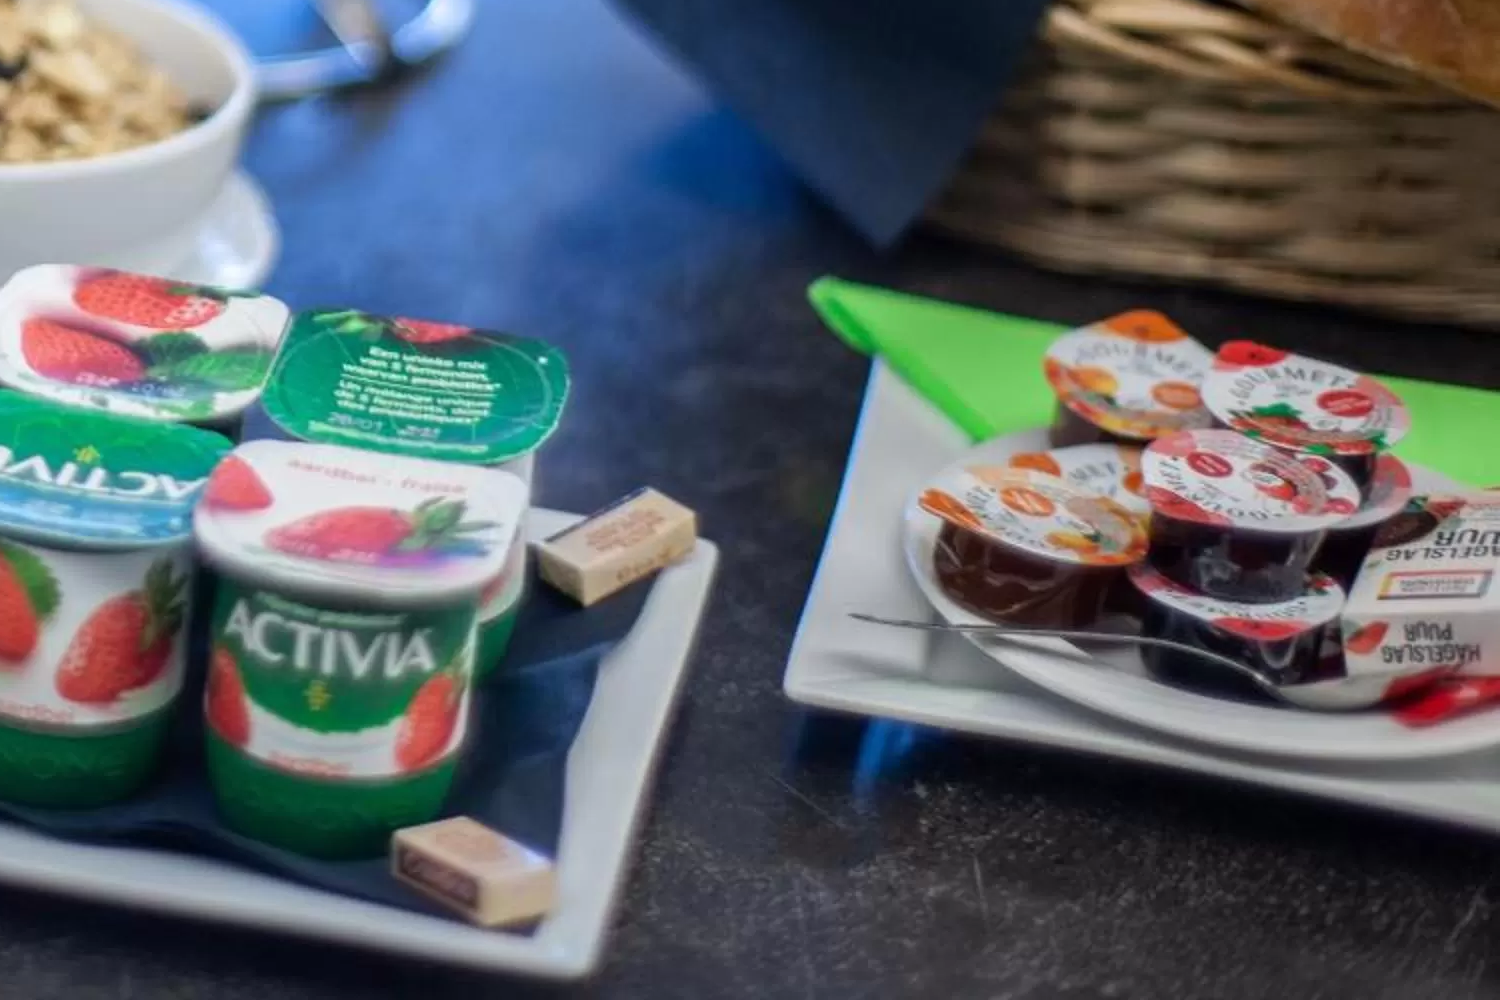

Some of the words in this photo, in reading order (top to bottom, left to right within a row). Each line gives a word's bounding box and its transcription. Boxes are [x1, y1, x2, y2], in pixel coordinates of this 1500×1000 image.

[223, 597, 436, 679] ACTIVIA
[1404, 621, 1454, 642] PUUR
[1381, 644, 1481, 664] HAGELSLAG
